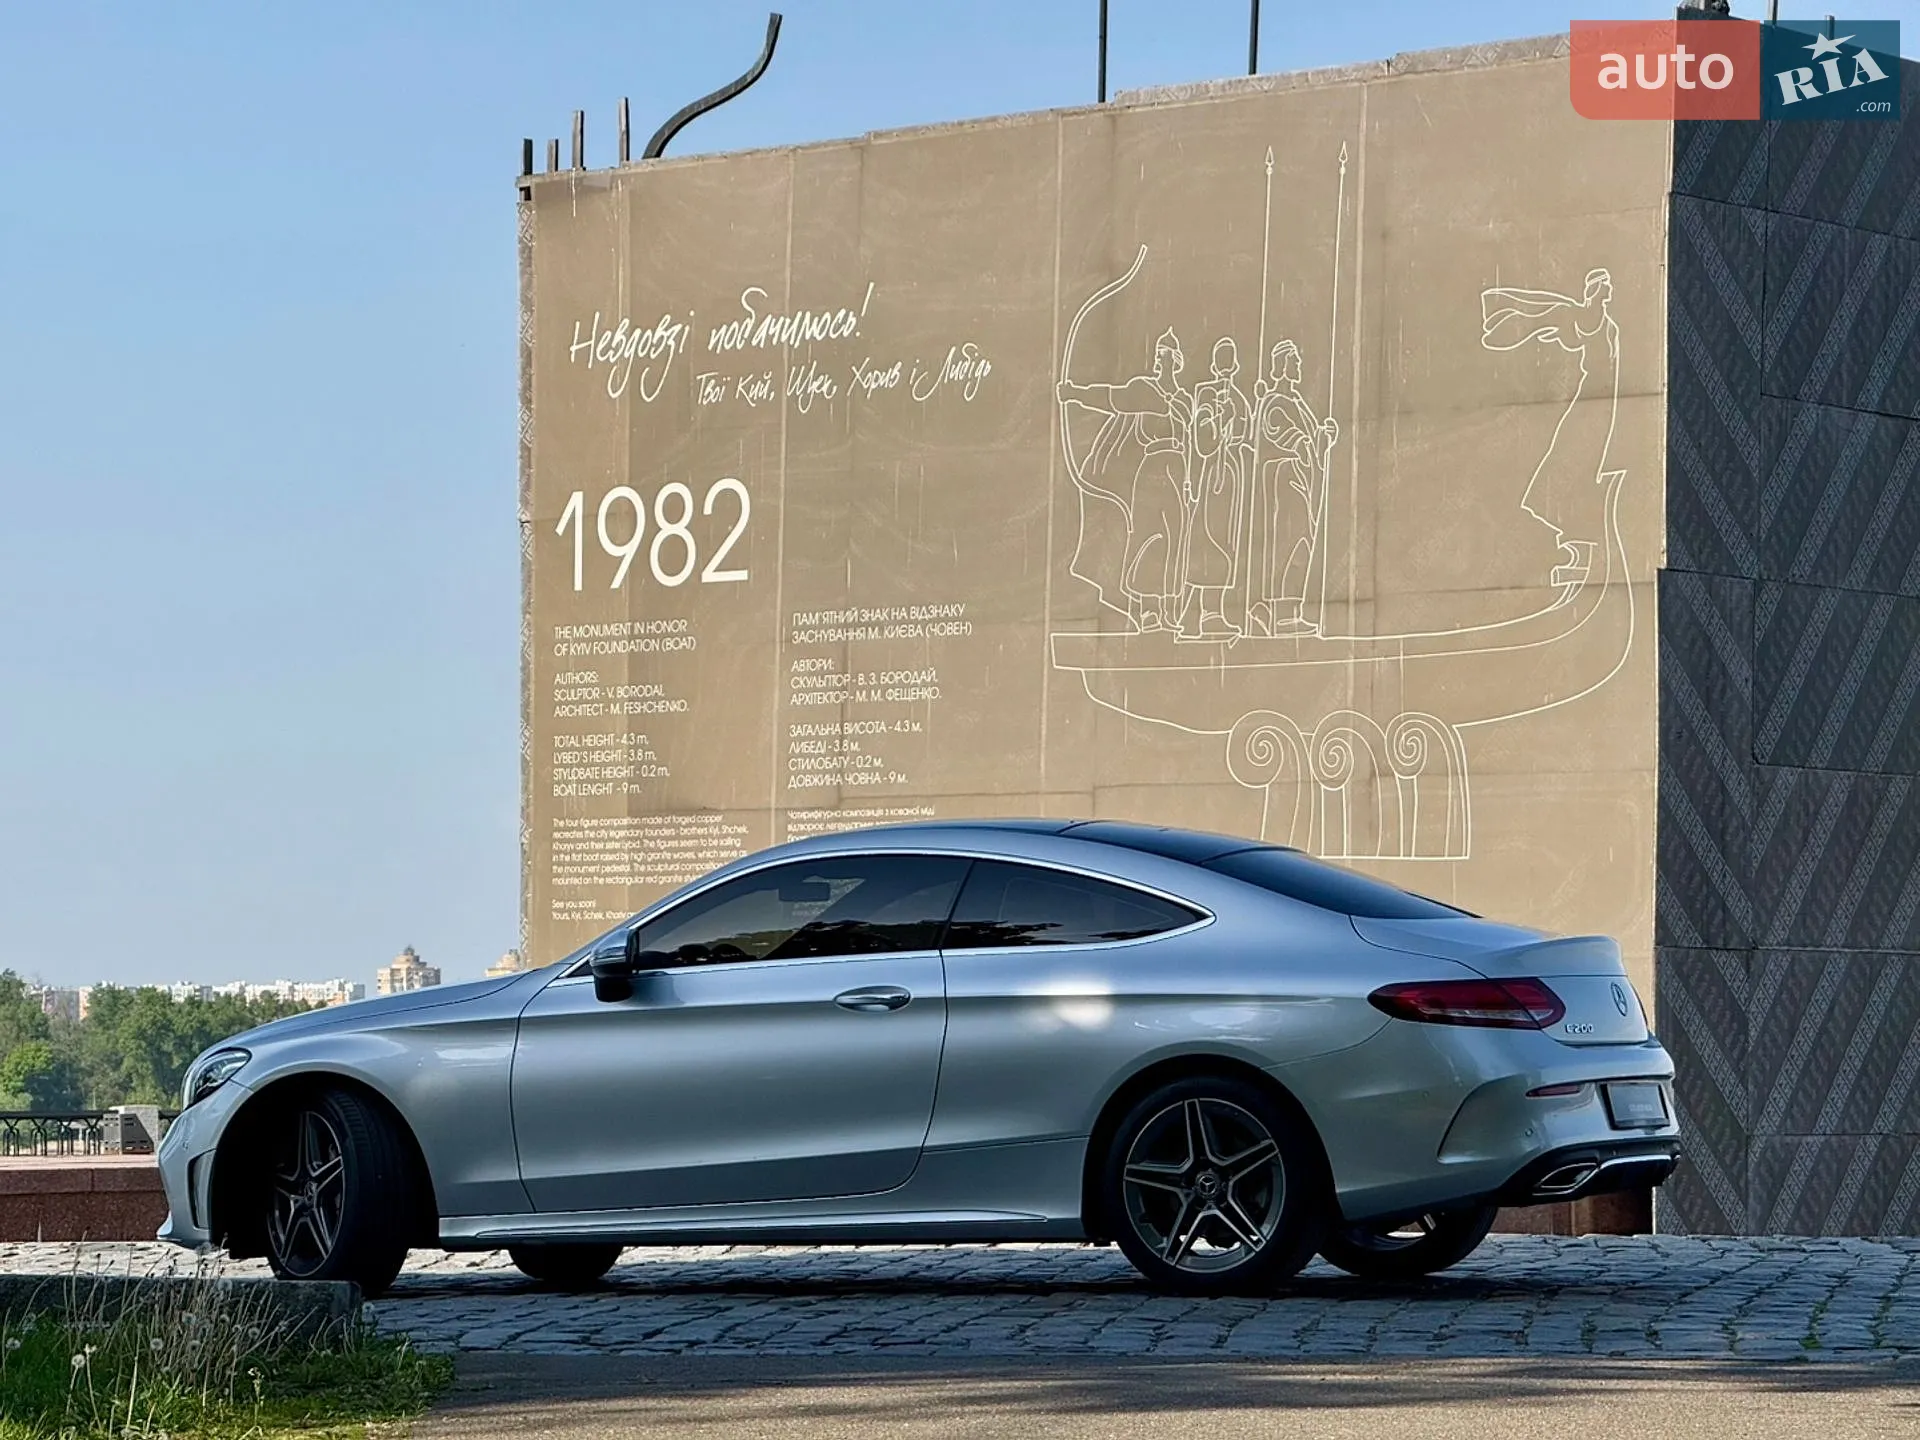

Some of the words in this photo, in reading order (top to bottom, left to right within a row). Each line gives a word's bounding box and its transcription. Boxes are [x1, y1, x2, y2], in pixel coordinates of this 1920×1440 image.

[570, 311, 694, 402] Невдовзі
[708, 282, 874, 354] побачимось!
[696, 371, 726, 405] Твої
[847, 357, 902, 398] Хорив
[913, 342, 993, 401] Либідь
[554, 477, 752, 592] 1982
[860, 608, 889, 622] ЗНАК
[891, 606, 908, 620] НА
[910, 603, 966, 620] ВІДЗНАКУ
[554, 626, 571, 639] THE
[574, 621, 631, 638] MONUMENT
[634, 621, 644, 635] IN
[647, 619, 688, 634] HONOR
[792, 627, 866, 644] ЗАСНУВАННЯ
[868, 627, 882, 640] М.
[884, 623, 924, 639] КИЄВА
[925, 621, 972, 638] (ЧОВЕН)
[554, 643, 568, 656] OF
[570, 640, 592, 655] KYIV
[594, 638, 660, 655] FOUNDATION
[661, 635, 696, 651] (BOAT)
[791, 658, 835, 672] АВТОРИ:
[554, 671, 600, 684] AUTHORS:
[790, 674, 850, 689] СКУЛЬПТОР
[554, 687, 600, 701] SCULPTOR
[607, 687, 615, 699] V.
[790, 691, 849, 706] АРХІТЕКТОР
[885, 686, 942, 701] ФЕЩЕНКО.
[554, 703, 604, 717] ARCHITECT
[610, 703, 622, 715] M.
[789, 722, 842, 738] ЗАГАЛЬНА
[843, 720, 886, 735] ВИСОТА
[894, 720, 910, 732] 4.3
[554, 735, 580, 748] TOTAL
[582, 733, 615, 747] HEIGHT
[788, 740, 827, 755] ЛИБЕДІ
[590, 749, 622, 763] HEIGHT
[788, 757, 849, 771] СТИЛОБАТУ
[554, 766, 600, 780] STYLOBATE
[601, 765, 634, 779] HEIGHT
[788, 774, 843, 789] ДОВЖИНА
[844, 771, 881, 785] ЧОВНА
[889, 771, 895, 783] 9
[554, 783, 576, 797] BOAT
[622, 782, 628, 793] 9
